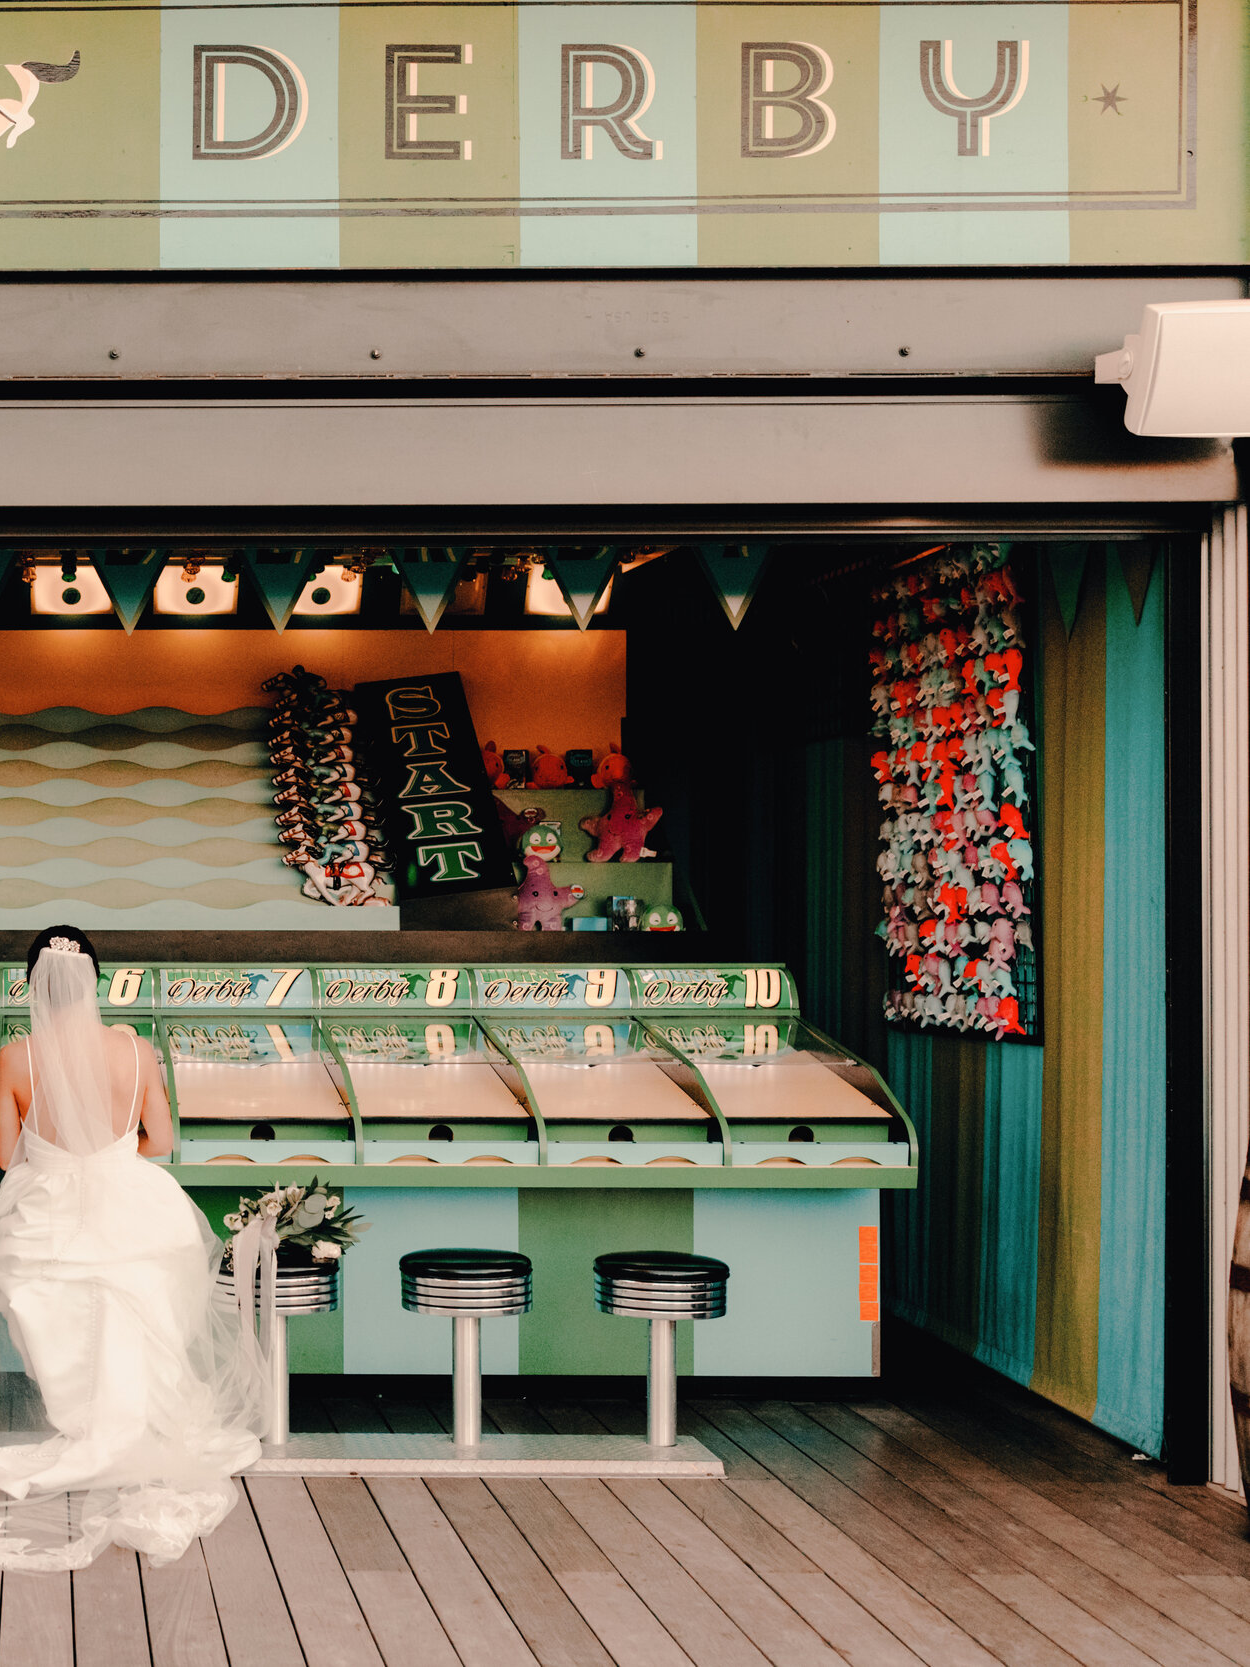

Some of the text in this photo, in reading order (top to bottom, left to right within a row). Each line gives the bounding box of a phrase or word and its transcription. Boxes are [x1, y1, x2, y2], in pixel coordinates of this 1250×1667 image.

[191, 39, 1031, 162] DERBY
[384, 685, 485, 882] START
[107, 968, 146, 1007] 6
[166, 977, 252, 1007] Derby
[265, 968, 304, 1007] 7
[324, 977, 410, 1007] Derby
[425, 968, 460, 1007] 8
[483, 977, 570, 1007] Derby
[584, 968, 618, 1007] 9
[642, 977, 728, 1007] Derby
[742, 968, 781, 1008] 10
